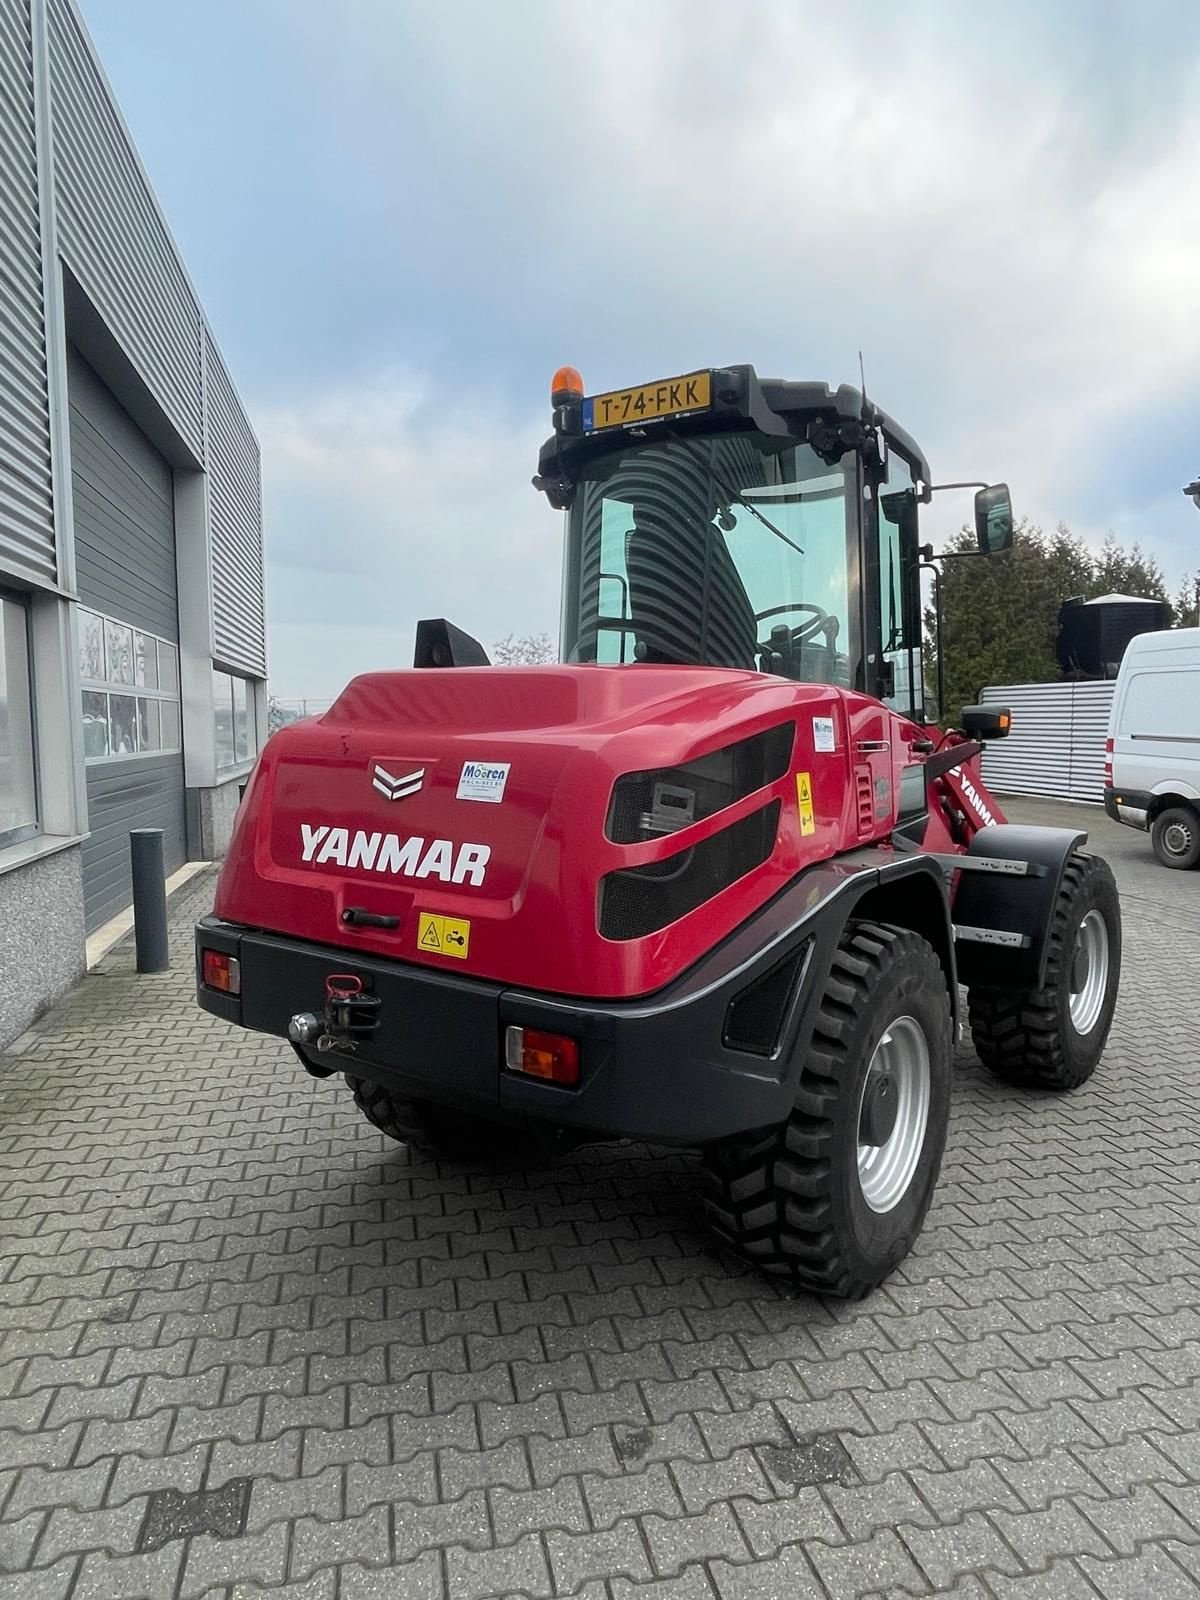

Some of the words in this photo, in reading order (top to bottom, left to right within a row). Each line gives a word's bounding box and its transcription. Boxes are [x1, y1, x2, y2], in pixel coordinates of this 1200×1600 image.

[601, 379, 699, 422] T-74-FKK
[464, 765, 505, 779] Mooren
[960, 773, 997, 827] YANM
[301, 824, 491, 886] YANMAR
